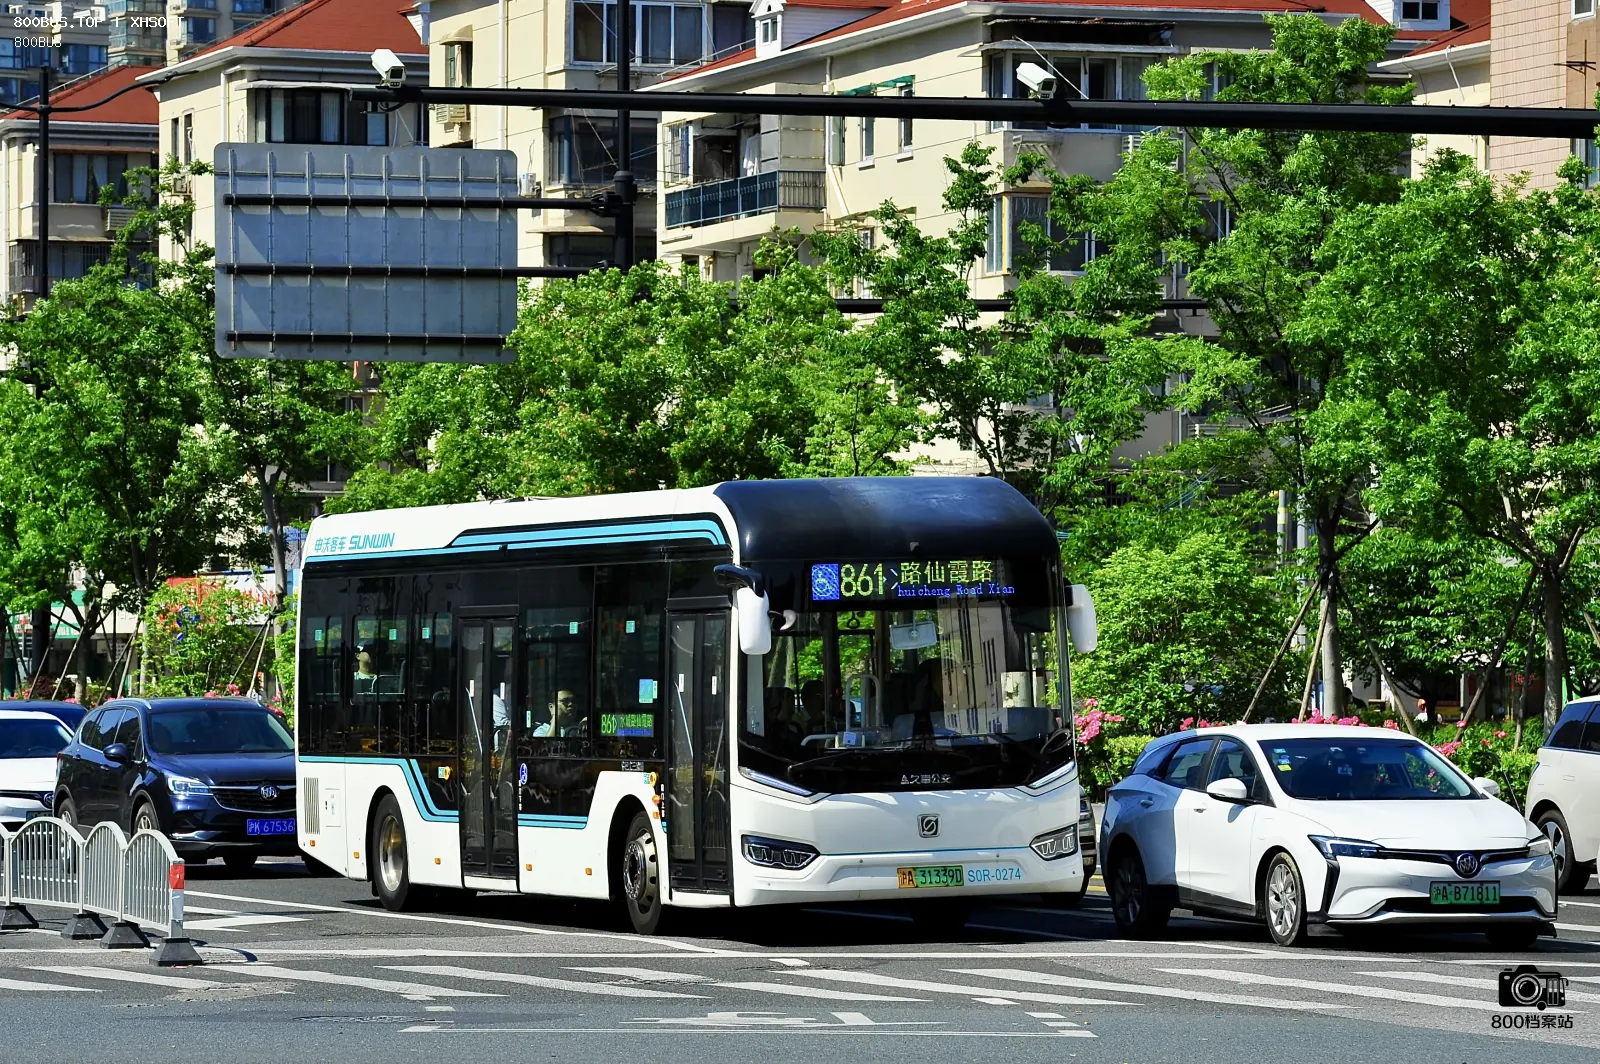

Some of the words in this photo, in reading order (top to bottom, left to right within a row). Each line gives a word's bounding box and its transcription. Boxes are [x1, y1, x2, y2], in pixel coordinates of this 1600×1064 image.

[314, 536, 347, 553] 申沃客车
[349, 533, 395, 550] SUNWIN
[840, 563, 884, 597] 861
[900, 560, 993, 585] 路仙霞路
[956, 583, 983, 596] Road
[988, 582, 1015, 595] Xian
